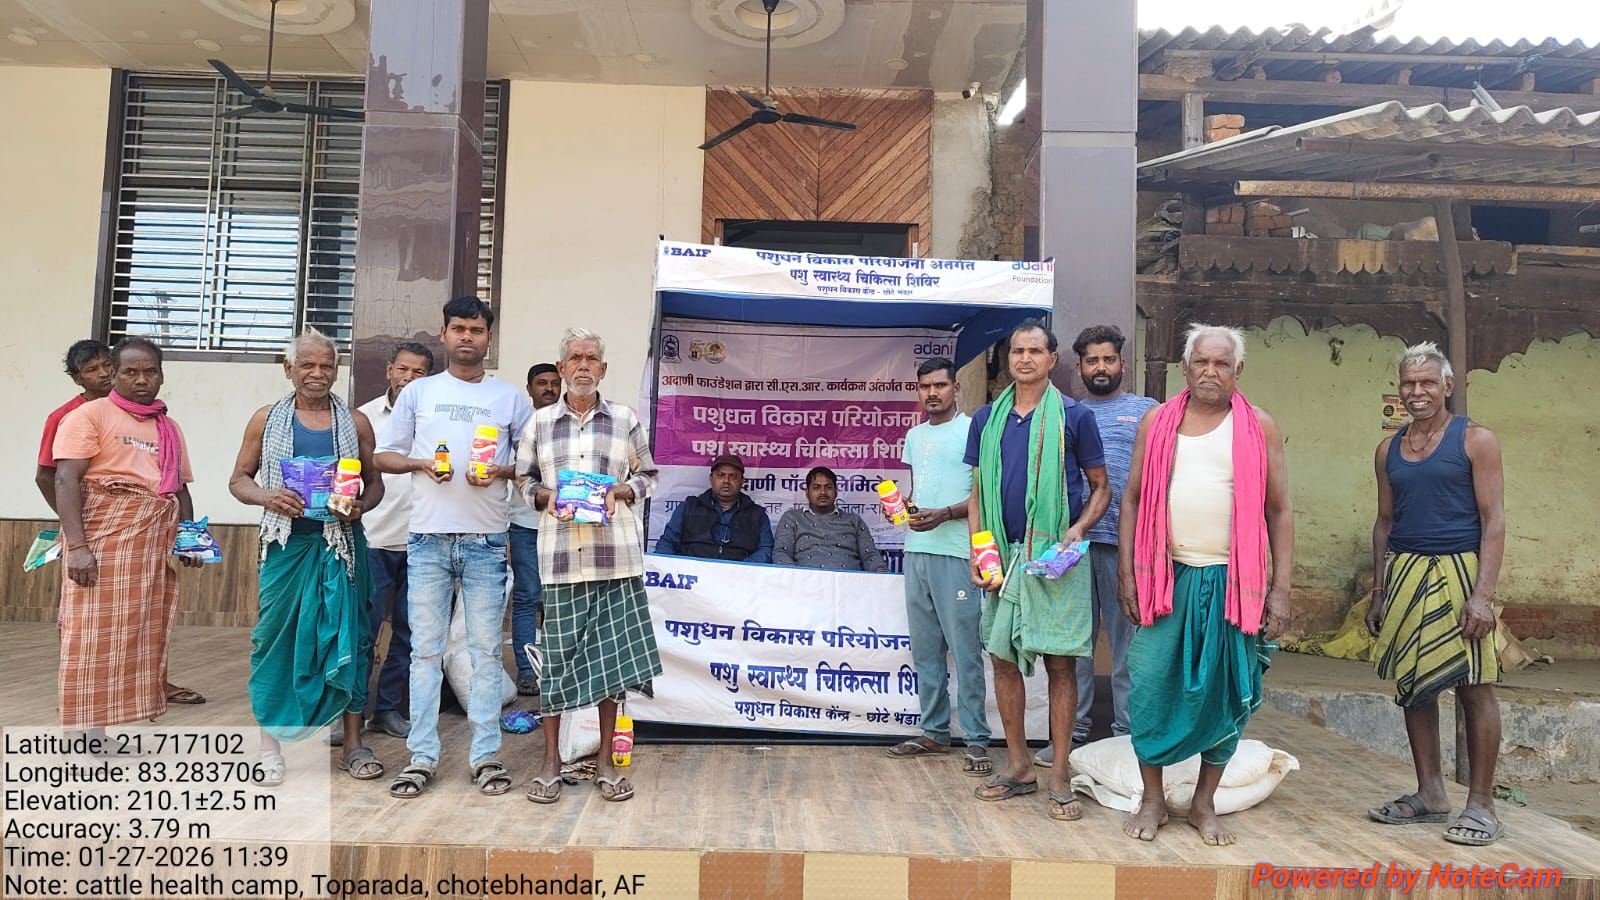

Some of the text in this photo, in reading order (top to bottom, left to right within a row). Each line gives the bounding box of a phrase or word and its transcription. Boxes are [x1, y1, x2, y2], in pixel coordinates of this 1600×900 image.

[671, 247, 711, 257] BAIF
[790, 269, 940, 288] पशु स्वास्थ्य चिकित्सा शिविर
[1012, 275, 1053, 284] Foundation
[914, 341, 953, 355] adani
[662, 374, 693, 386] अदाणी
[697, 376, 742, 390] फाउंडेशन
[744, 379, 763, 391] द्वारा
[827, 379, 866, 391] कार्यक्रम
[869, 379, 902, 392] अंतर्गत
[693, 405, 922, 432] पशुधन विकास परियोजना
[728, 441, 791, 459] स्वास्थ्य
[795, 437, 869, 459] चिकित्सा
[645, 571, 698, 590] BAIF
[665, 620, 735, 645] पशुधन
[742, 619, 816, 646] विकास
[710, 662, 739, 693] पशु
[748, 664, 808, 690] स्वास्थ्य
[816, 660, 890, 694] चिकित्सा
[735, 700, 775, 721] पशुधन
[779, 699, 821, 719] विकास
[867, 707, 890, 723] छोटे
